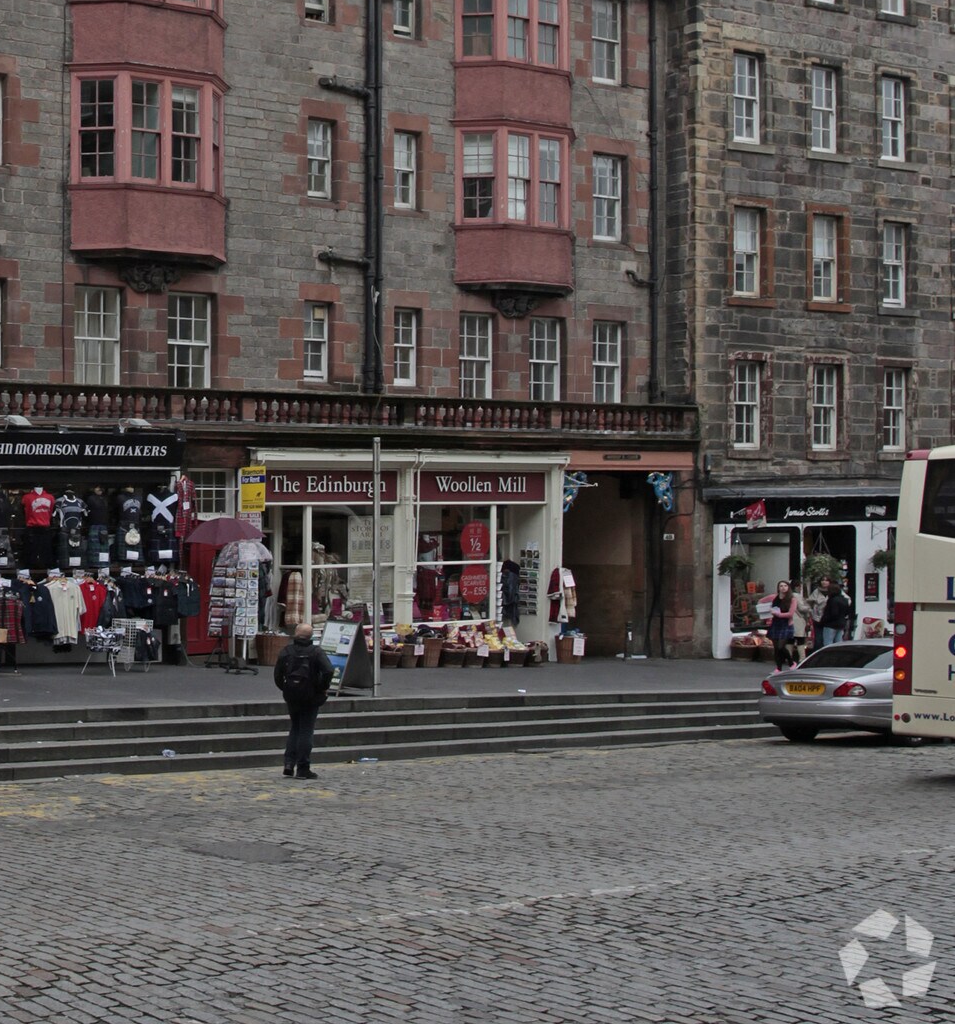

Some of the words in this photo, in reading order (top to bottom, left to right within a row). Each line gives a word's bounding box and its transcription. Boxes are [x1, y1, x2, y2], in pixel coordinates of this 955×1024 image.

[84, 444, 168, 457] KILTMAKERS
[270, 475, 300, 493] The
[435, 475, 492, 493] Woollen
[498, 476, 527, 493] Mill
[473, 587, 487, 595] £55
